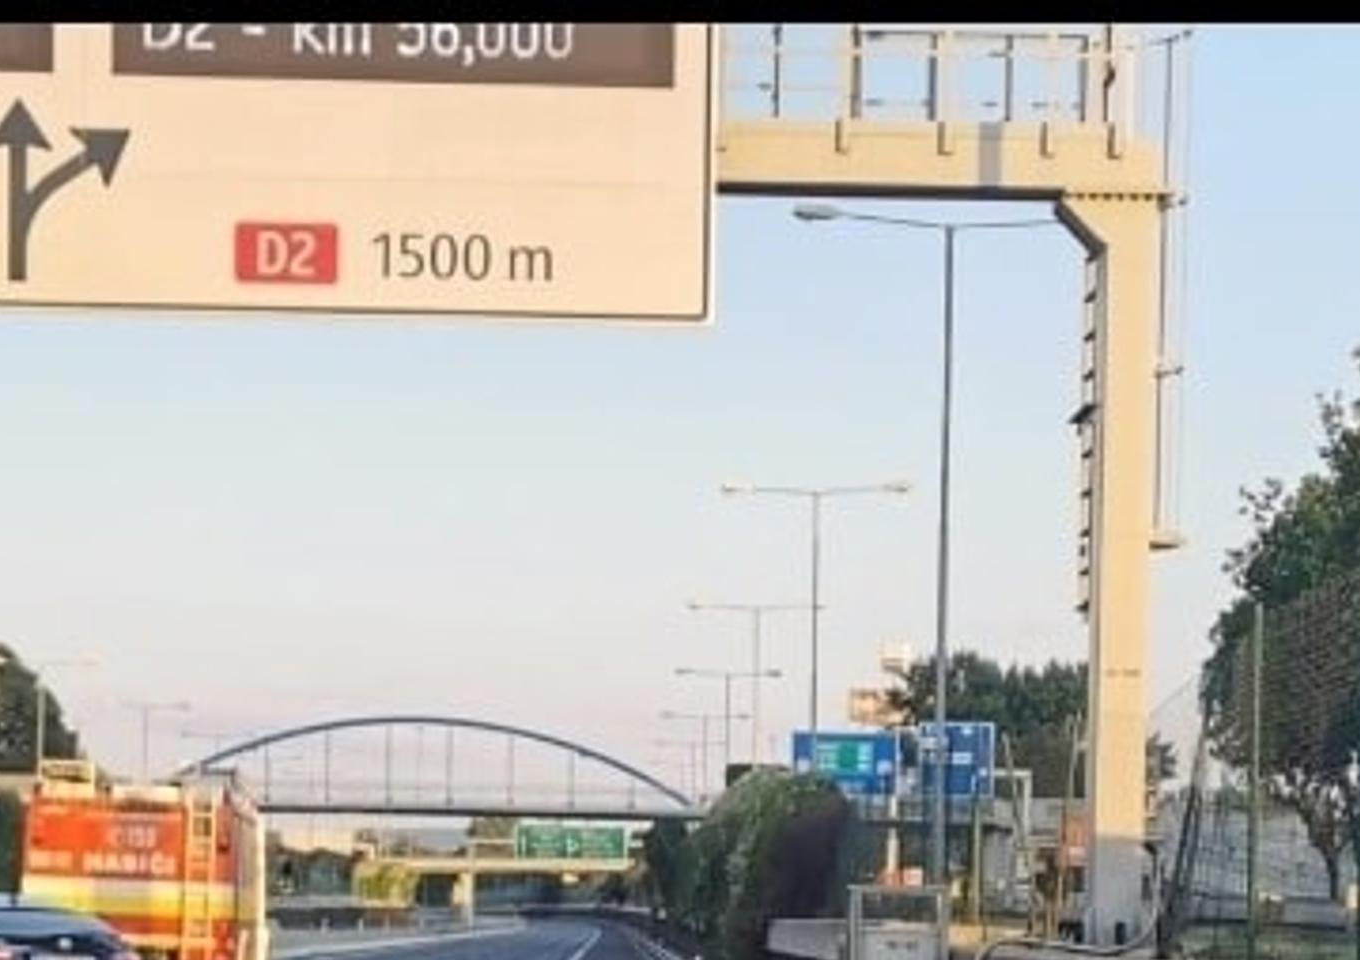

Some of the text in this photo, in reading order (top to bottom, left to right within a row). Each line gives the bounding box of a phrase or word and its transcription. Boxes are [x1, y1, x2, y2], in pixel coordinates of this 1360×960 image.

[255, 229, 554, 282] D2 1500 m
